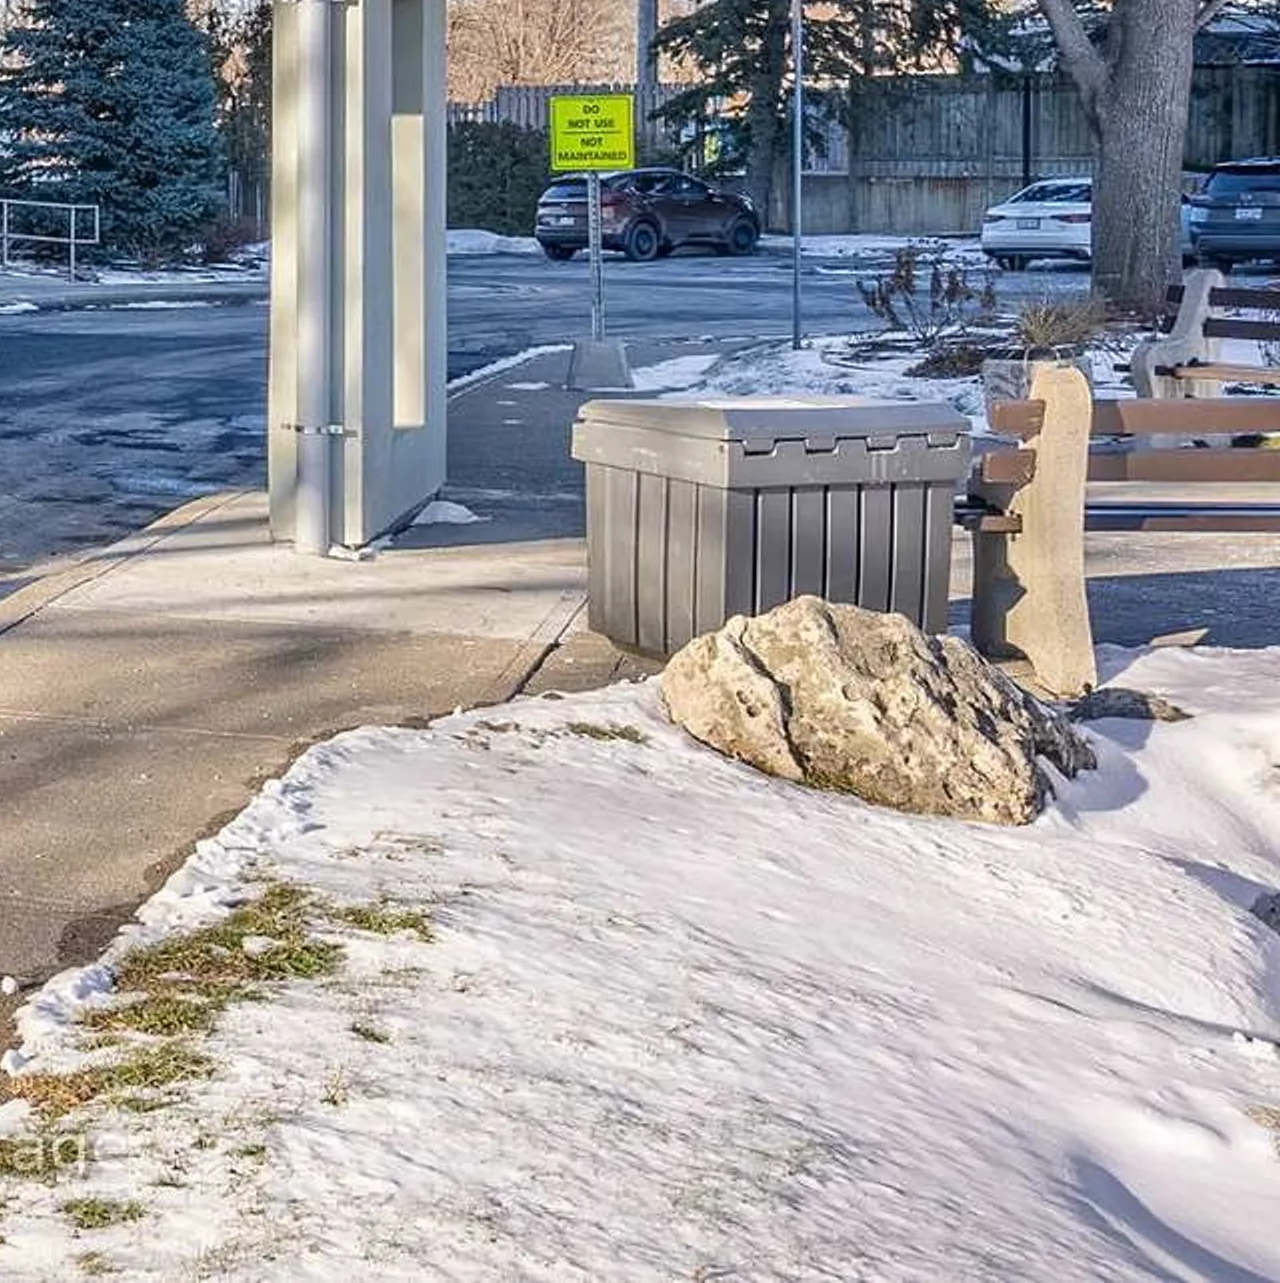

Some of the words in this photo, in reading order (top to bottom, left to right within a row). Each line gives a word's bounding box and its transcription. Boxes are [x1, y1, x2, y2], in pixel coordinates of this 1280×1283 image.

[582, 104, 601, 115] DO
[568, 118, 590, 129] NOT
[594, 118, 616, 129] USE
[580, 136, 603, 148] NOT
[558, 150, 628, 162] MAINTAINED
